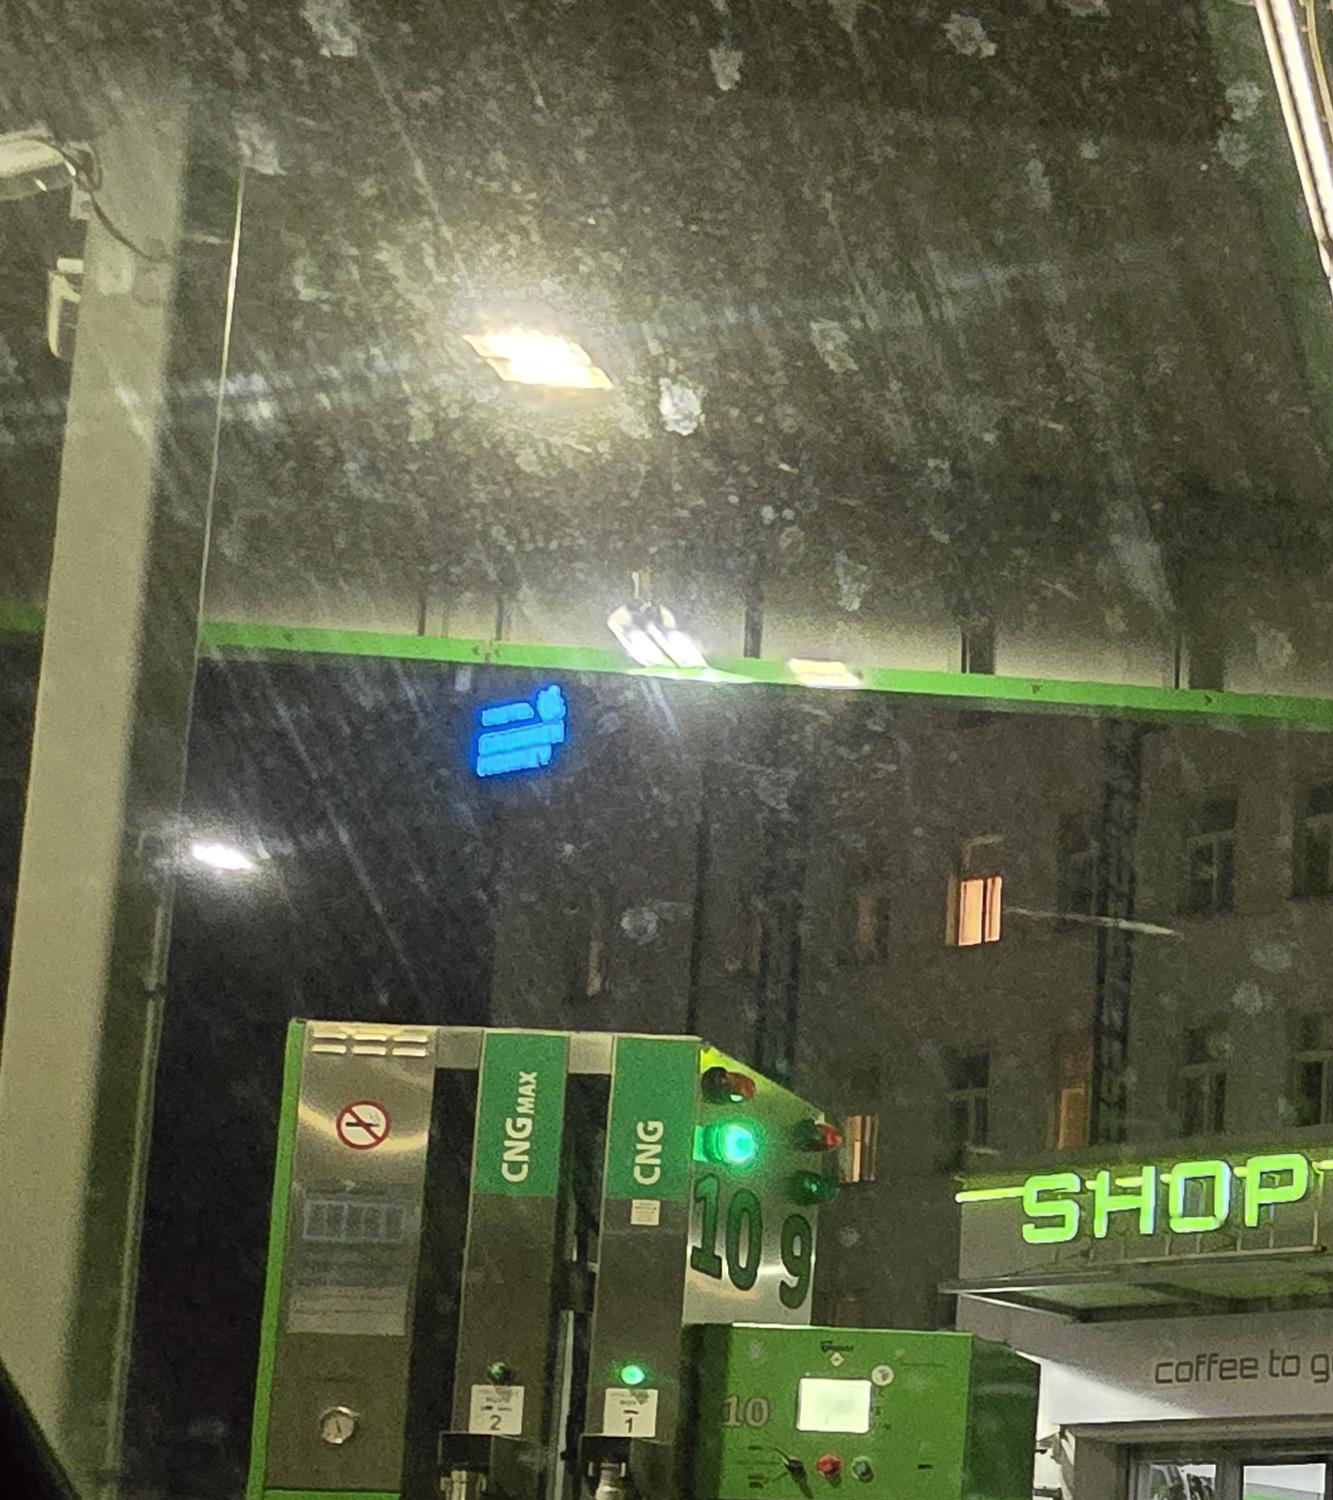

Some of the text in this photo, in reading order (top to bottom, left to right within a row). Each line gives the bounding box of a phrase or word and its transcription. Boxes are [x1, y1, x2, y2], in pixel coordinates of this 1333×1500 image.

[633, 1120, 664, 1185] CNG
[1021, 1153, 1309, 1244] SHOP
[690, 1173, 763, 1291] 10
[779, 1213, 812, 1309] 9
[1155, 1353, 1257, 1384] coffee
[1269, 1349, 1300, 1378] to
[489, 1415, 502, 1431] 2
[625, 1418, 634, 1433] 1
[722, 1394, 771, 1428] 10
